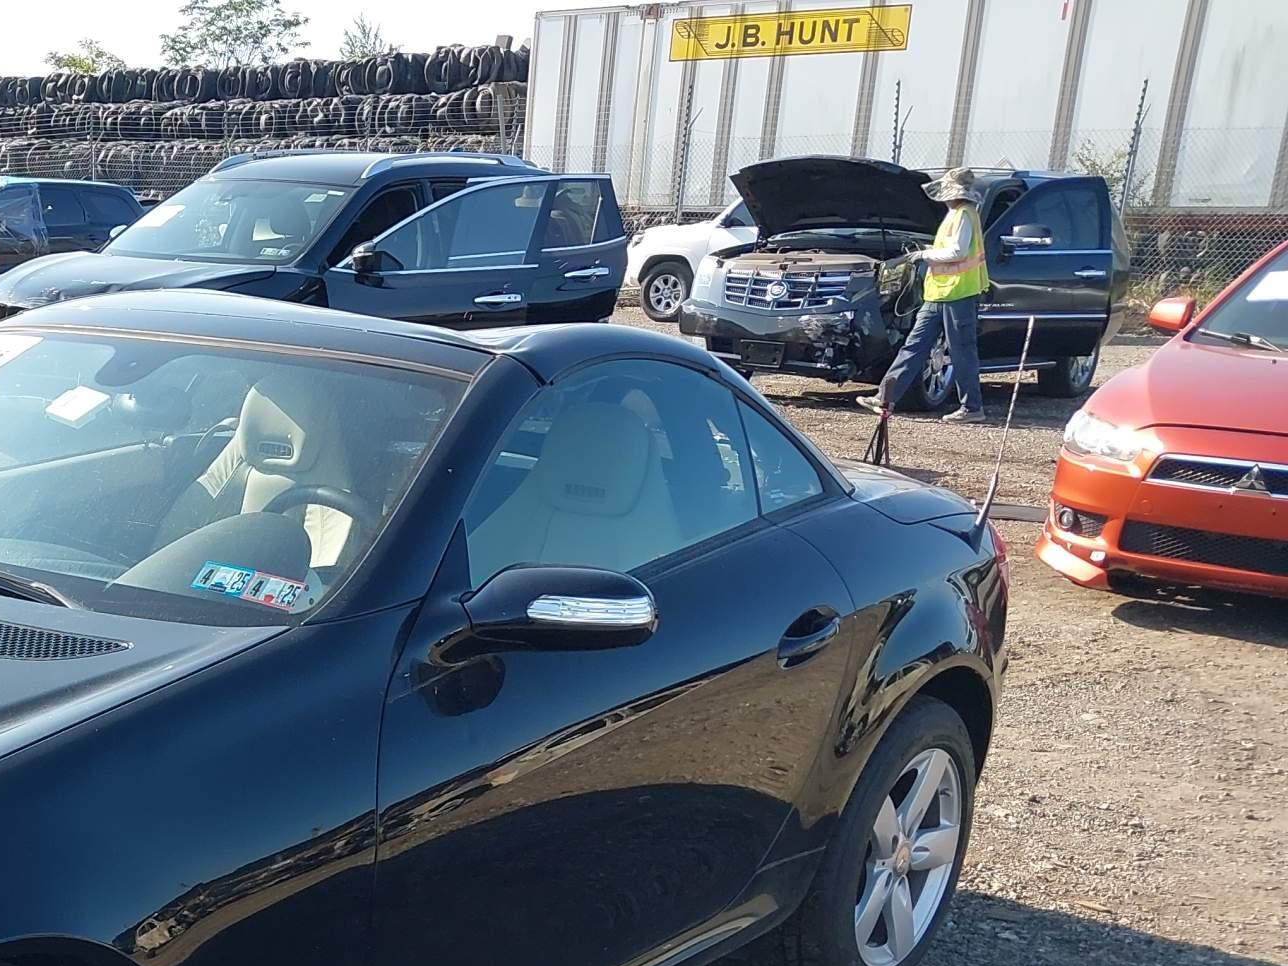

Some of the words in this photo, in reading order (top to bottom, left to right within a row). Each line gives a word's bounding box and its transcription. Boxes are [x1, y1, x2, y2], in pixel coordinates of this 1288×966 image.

[775, 18, 861, 46] HUNT
[230, 572, 251, 591] 25
[281, 585, 301, 606] 25
